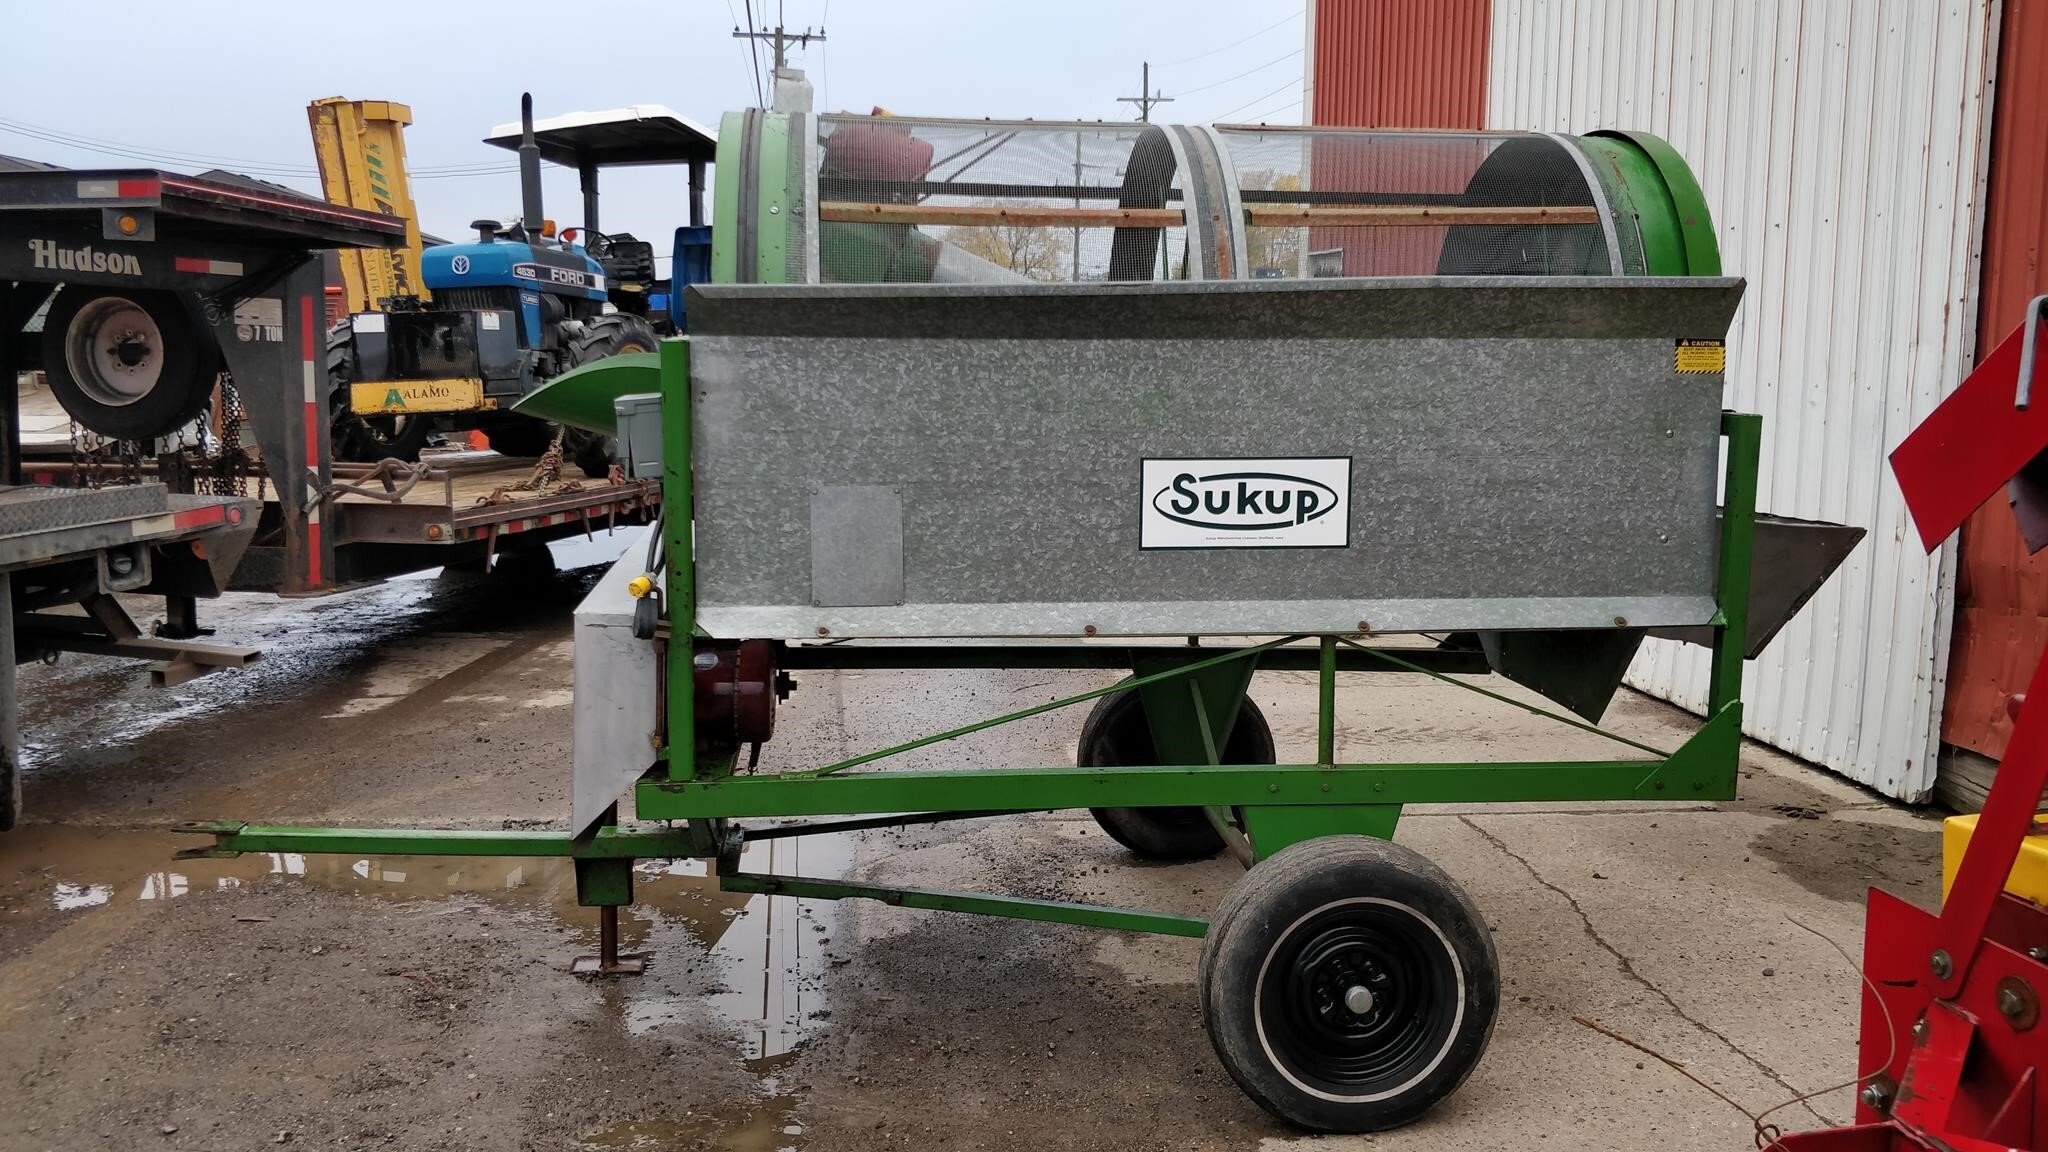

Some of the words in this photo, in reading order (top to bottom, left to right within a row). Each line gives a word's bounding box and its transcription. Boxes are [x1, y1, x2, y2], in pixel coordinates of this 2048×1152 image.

[28, 239, 142, 275] Hudson
[551, 268, 584, 285] FORD
[254, 325, 260, 341] 7
[404, 387, 450, 399] ALAMO
[1171, 473, 1319, 525] Sukup
